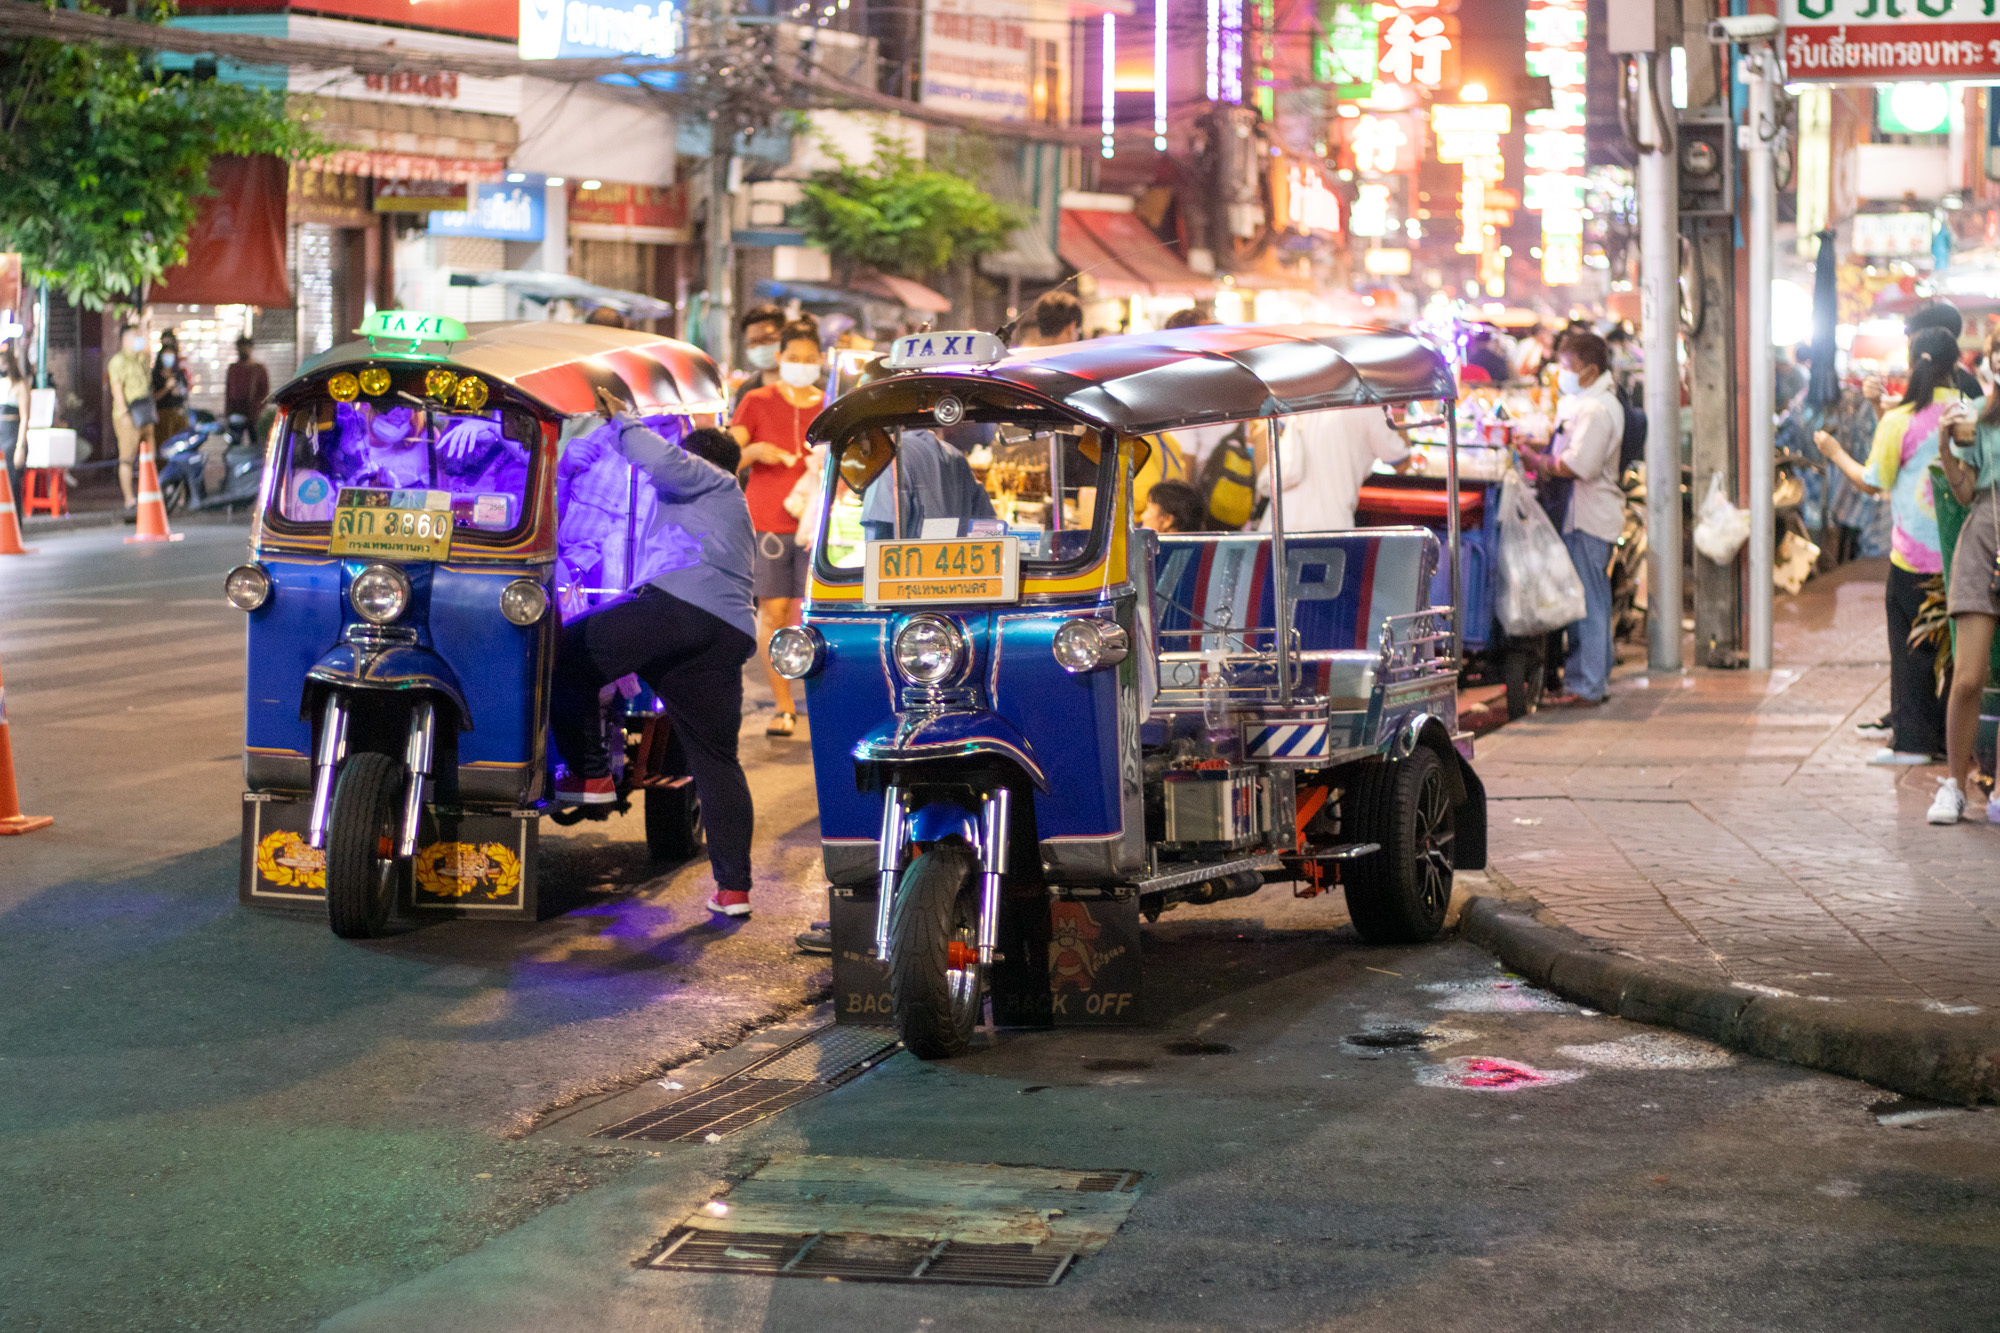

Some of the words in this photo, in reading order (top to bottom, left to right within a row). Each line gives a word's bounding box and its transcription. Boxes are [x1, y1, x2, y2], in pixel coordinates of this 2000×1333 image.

[1378, 0, 1452, 85] 行
[1787, 25, 1984, 68] รับเลี่ยมกรอบพระ
[381, 314, 443, 333] TAXI
[905, 336, 975, 357] TAXI
[338, 509, 374, 535] สก
[384, 511, 447, 538] 3860
[348, 540, 430, 553] กรุงเทพมหานคร
[884, 545, 922, 576] สก
[935, 544, 1000, 575] 4451
[897, 582, 987, 600] กรุงเทพมหานคร
[846, 993, 892, 1014] BAC
[1086, 993, 1132, 1015] OFF
